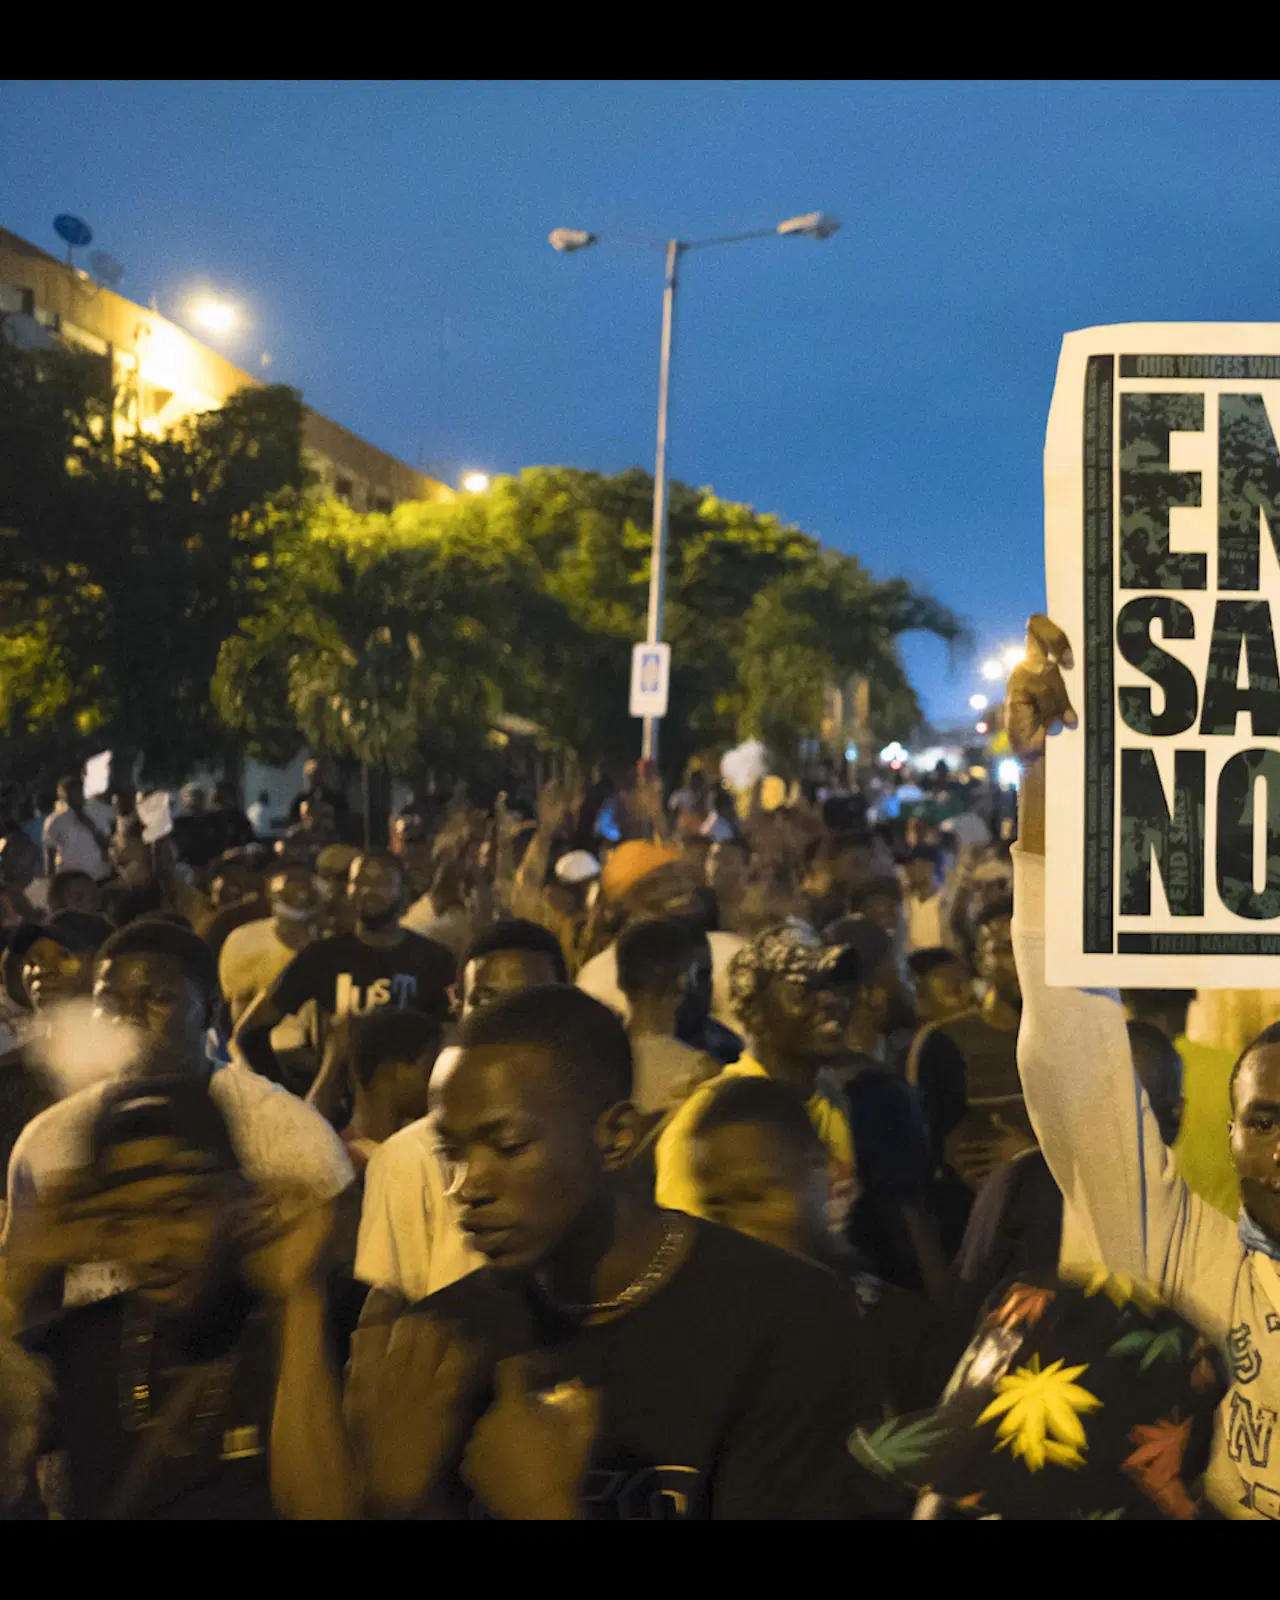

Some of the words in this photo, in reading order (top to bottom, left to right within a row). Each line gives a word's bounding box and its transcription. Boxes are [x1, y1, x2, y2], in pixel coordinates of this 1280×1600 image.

[1137, 355, 1174, 377] OUR
[1178, 355, 1244, 377] VOICES
[1151, 935, 1196, 953] THEIR
[1200, 935, 1256, 953] NAMES
